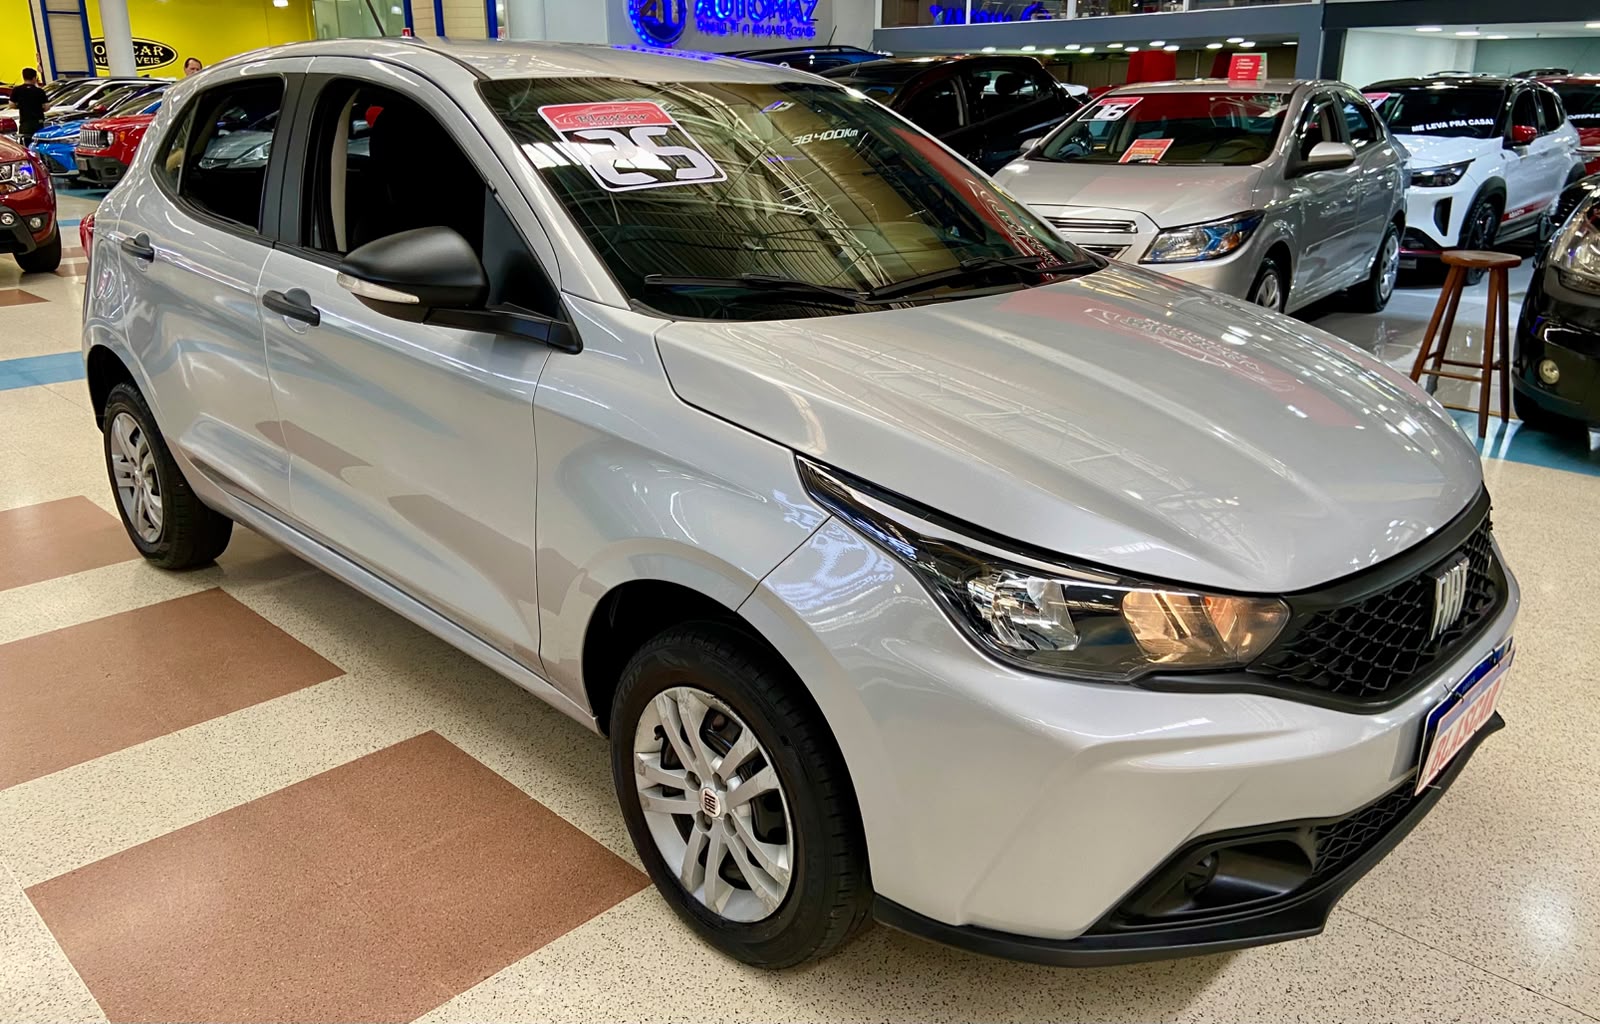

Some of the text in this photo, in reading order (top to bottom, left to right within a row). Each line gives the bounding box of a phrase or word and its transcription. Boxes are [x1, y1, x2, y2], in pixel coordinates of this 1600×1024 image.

[1094, 103, 1130, 119] 16
[1411, 124, 1425, 132] ME
[1425, 121, 1449, 130] LEVA
[1449, 119, 1467, 128] PRA
[573, 126, 716, 186] 25
[1430, 557, 1470, 641] FIAT
[704, 791, 715, 815] FIAT
